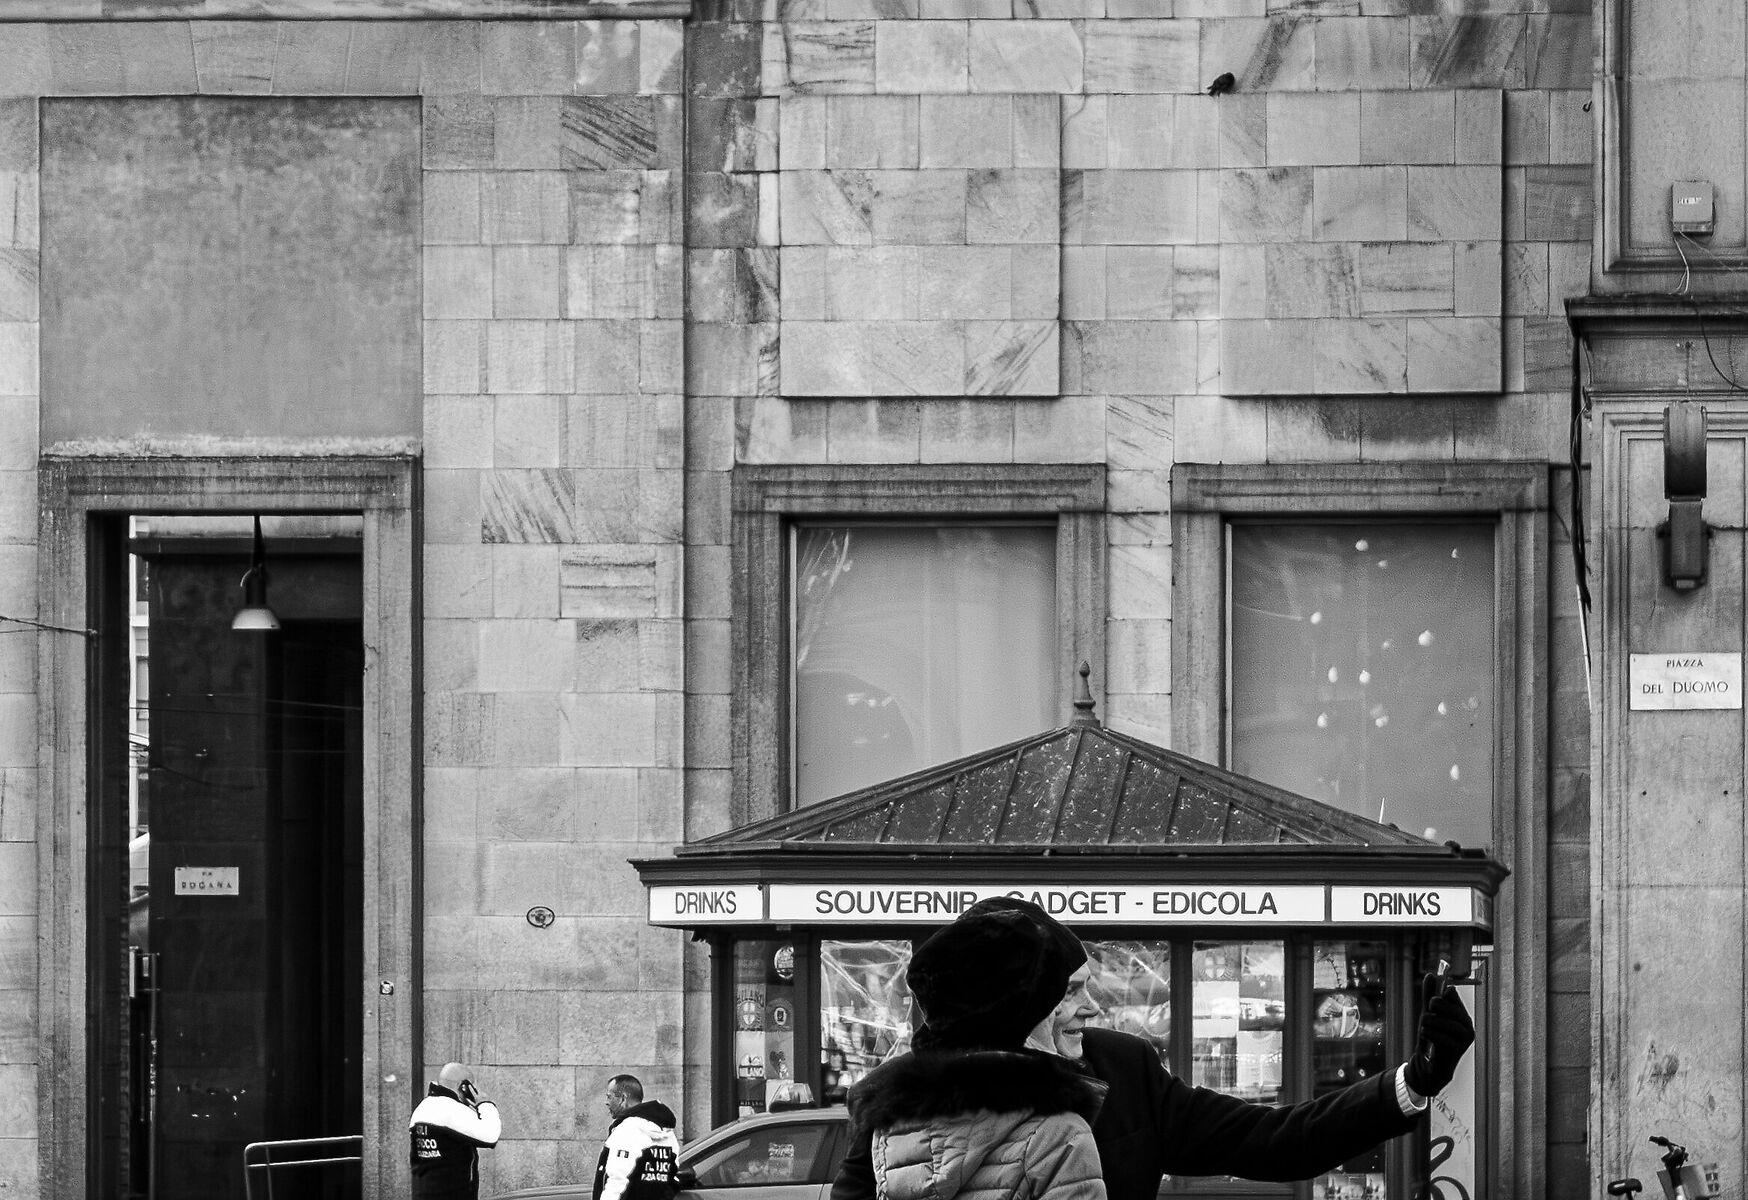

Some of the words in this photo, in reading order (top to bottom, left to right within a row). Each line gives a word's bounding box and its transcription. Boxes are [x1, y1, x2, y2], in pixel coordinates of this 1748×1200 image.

[1666, 659, 1703, 668] PIAZZA
[1642, 683, 1664, 694] DEL
[1673, 681, 1729, 694] DUOMO
[674, 891, 737, 915] DRINKS
[1153, 890, 1278, 915] EDICOLA
[1363, 892, 1441, 916] DRINKS
